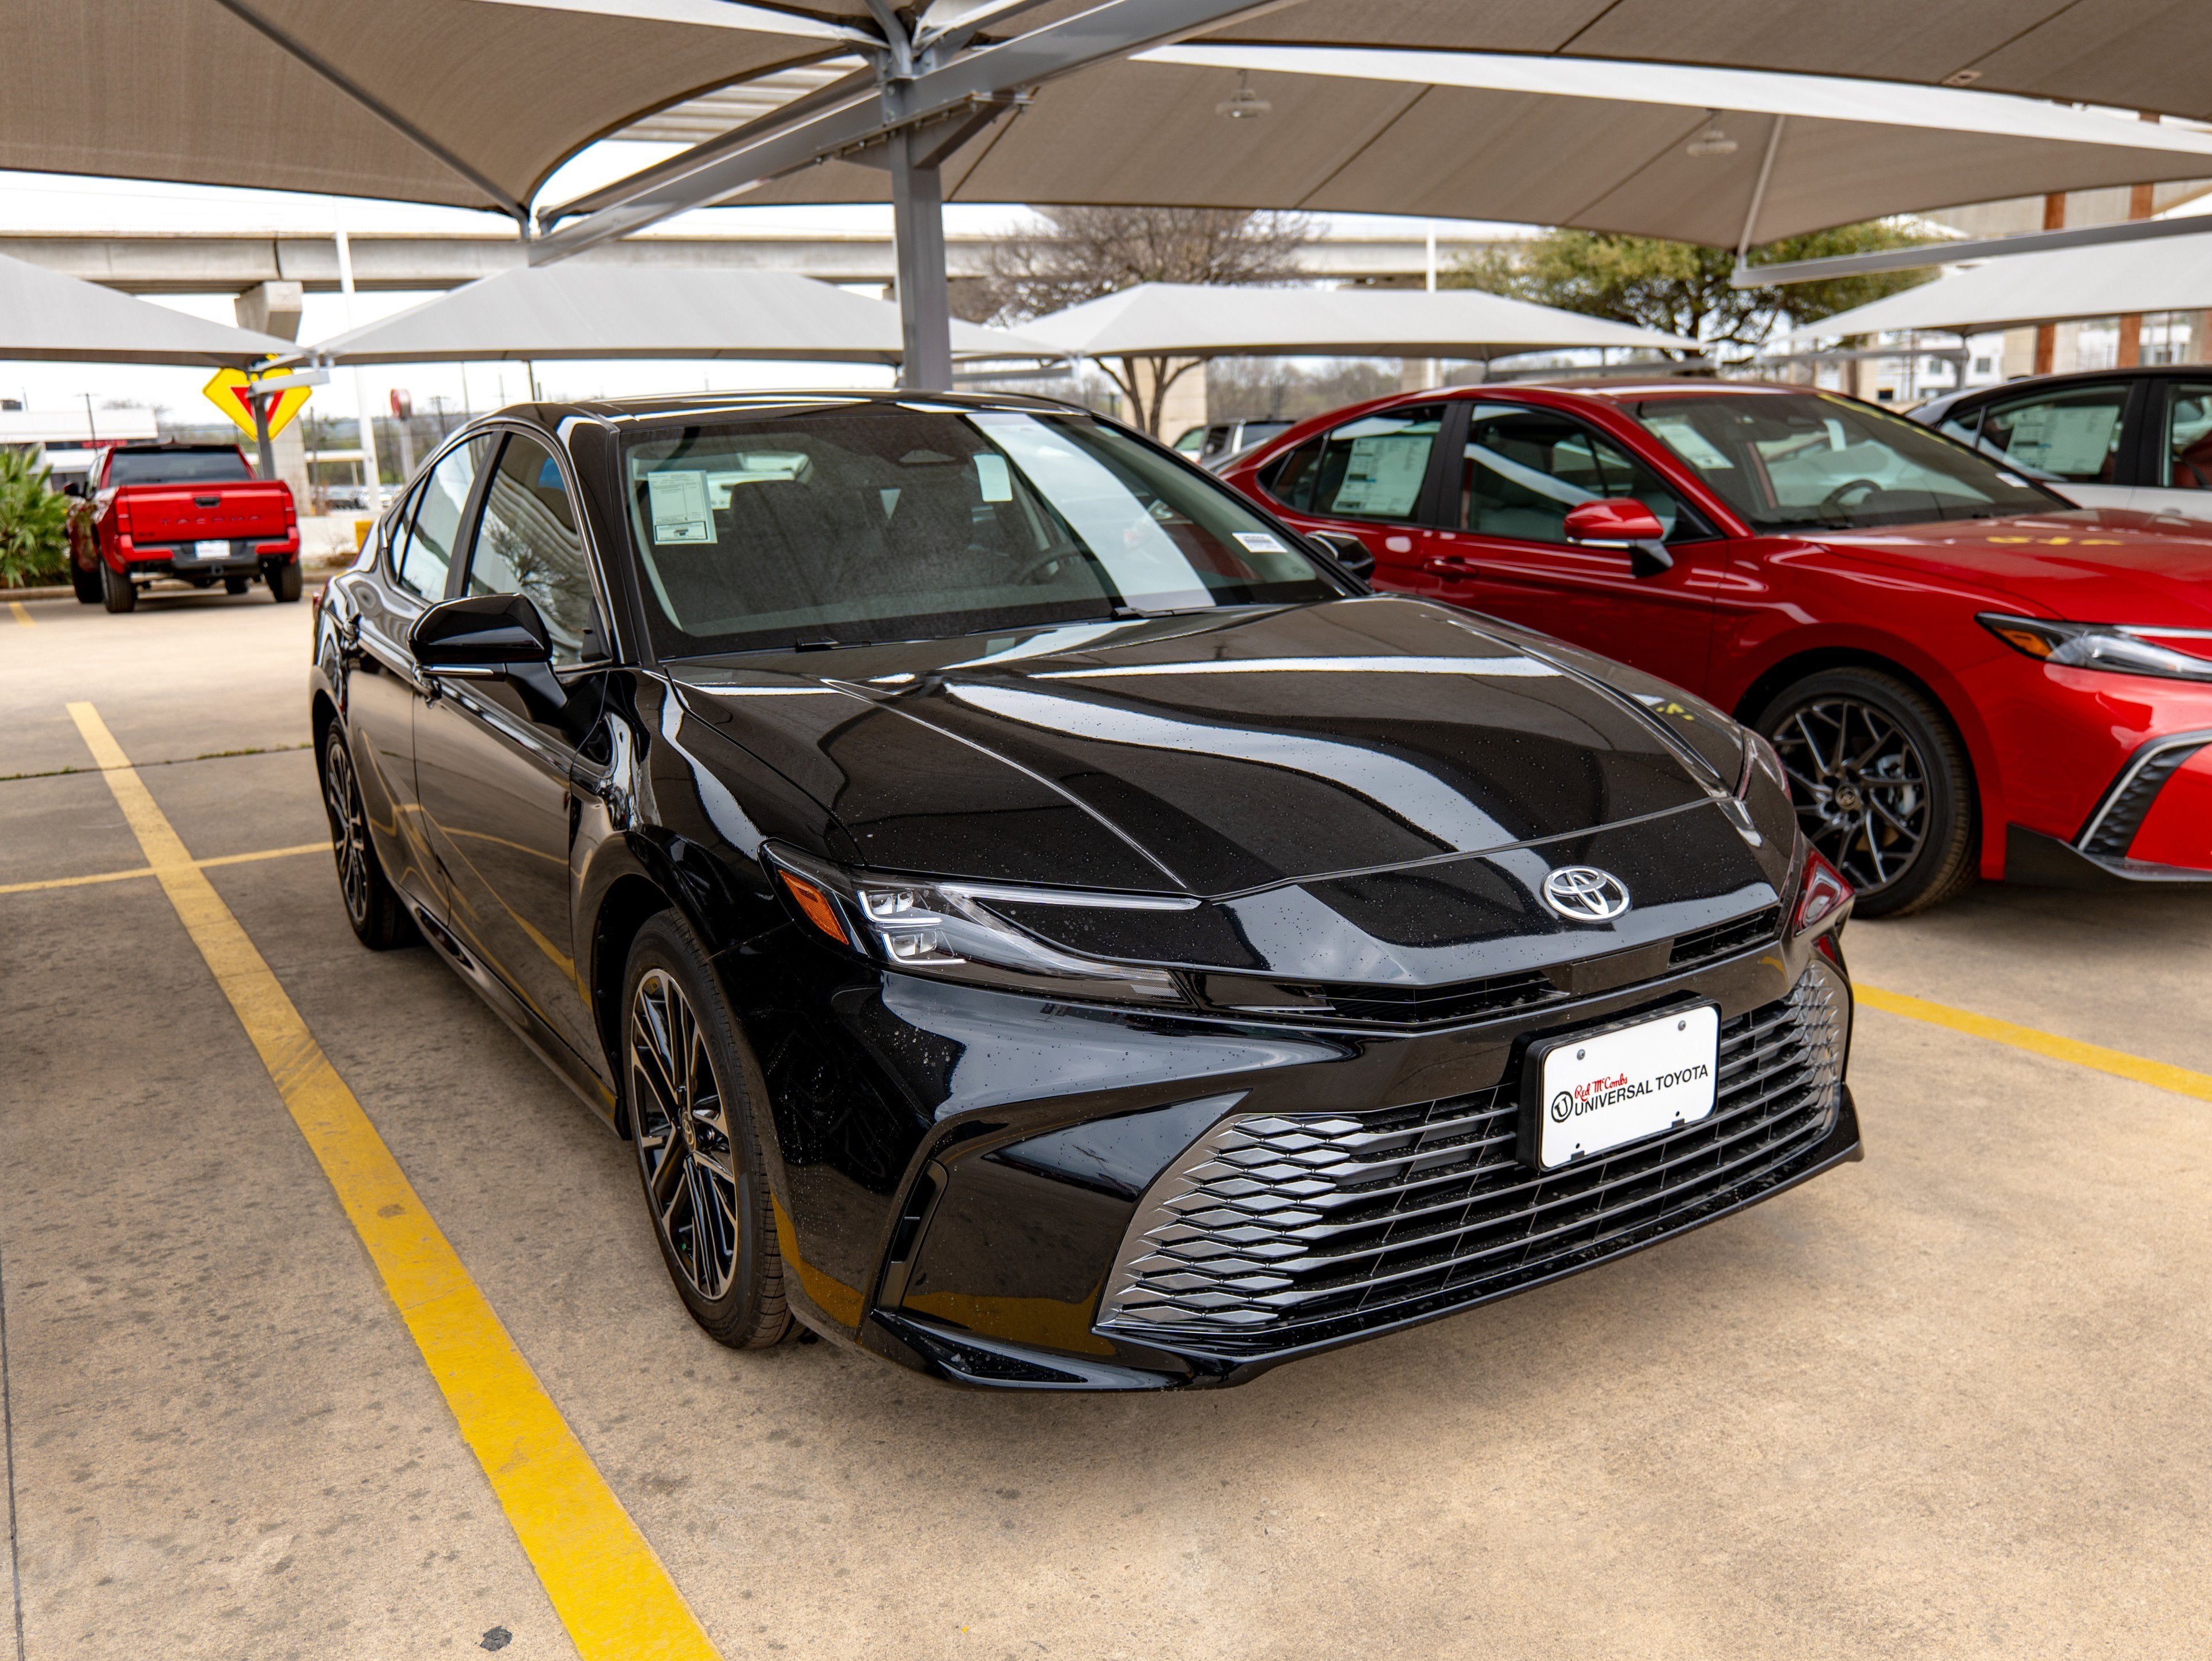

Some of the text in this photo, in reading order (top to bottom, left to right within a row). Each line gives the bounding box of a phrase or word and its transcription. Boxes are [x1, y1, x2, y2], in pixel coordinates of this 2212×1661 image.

[1574, 1073, 1628, 1102] Red McCombs
[1574, 1064, 1709, 1117] UNIVERSAL TOYOTA
